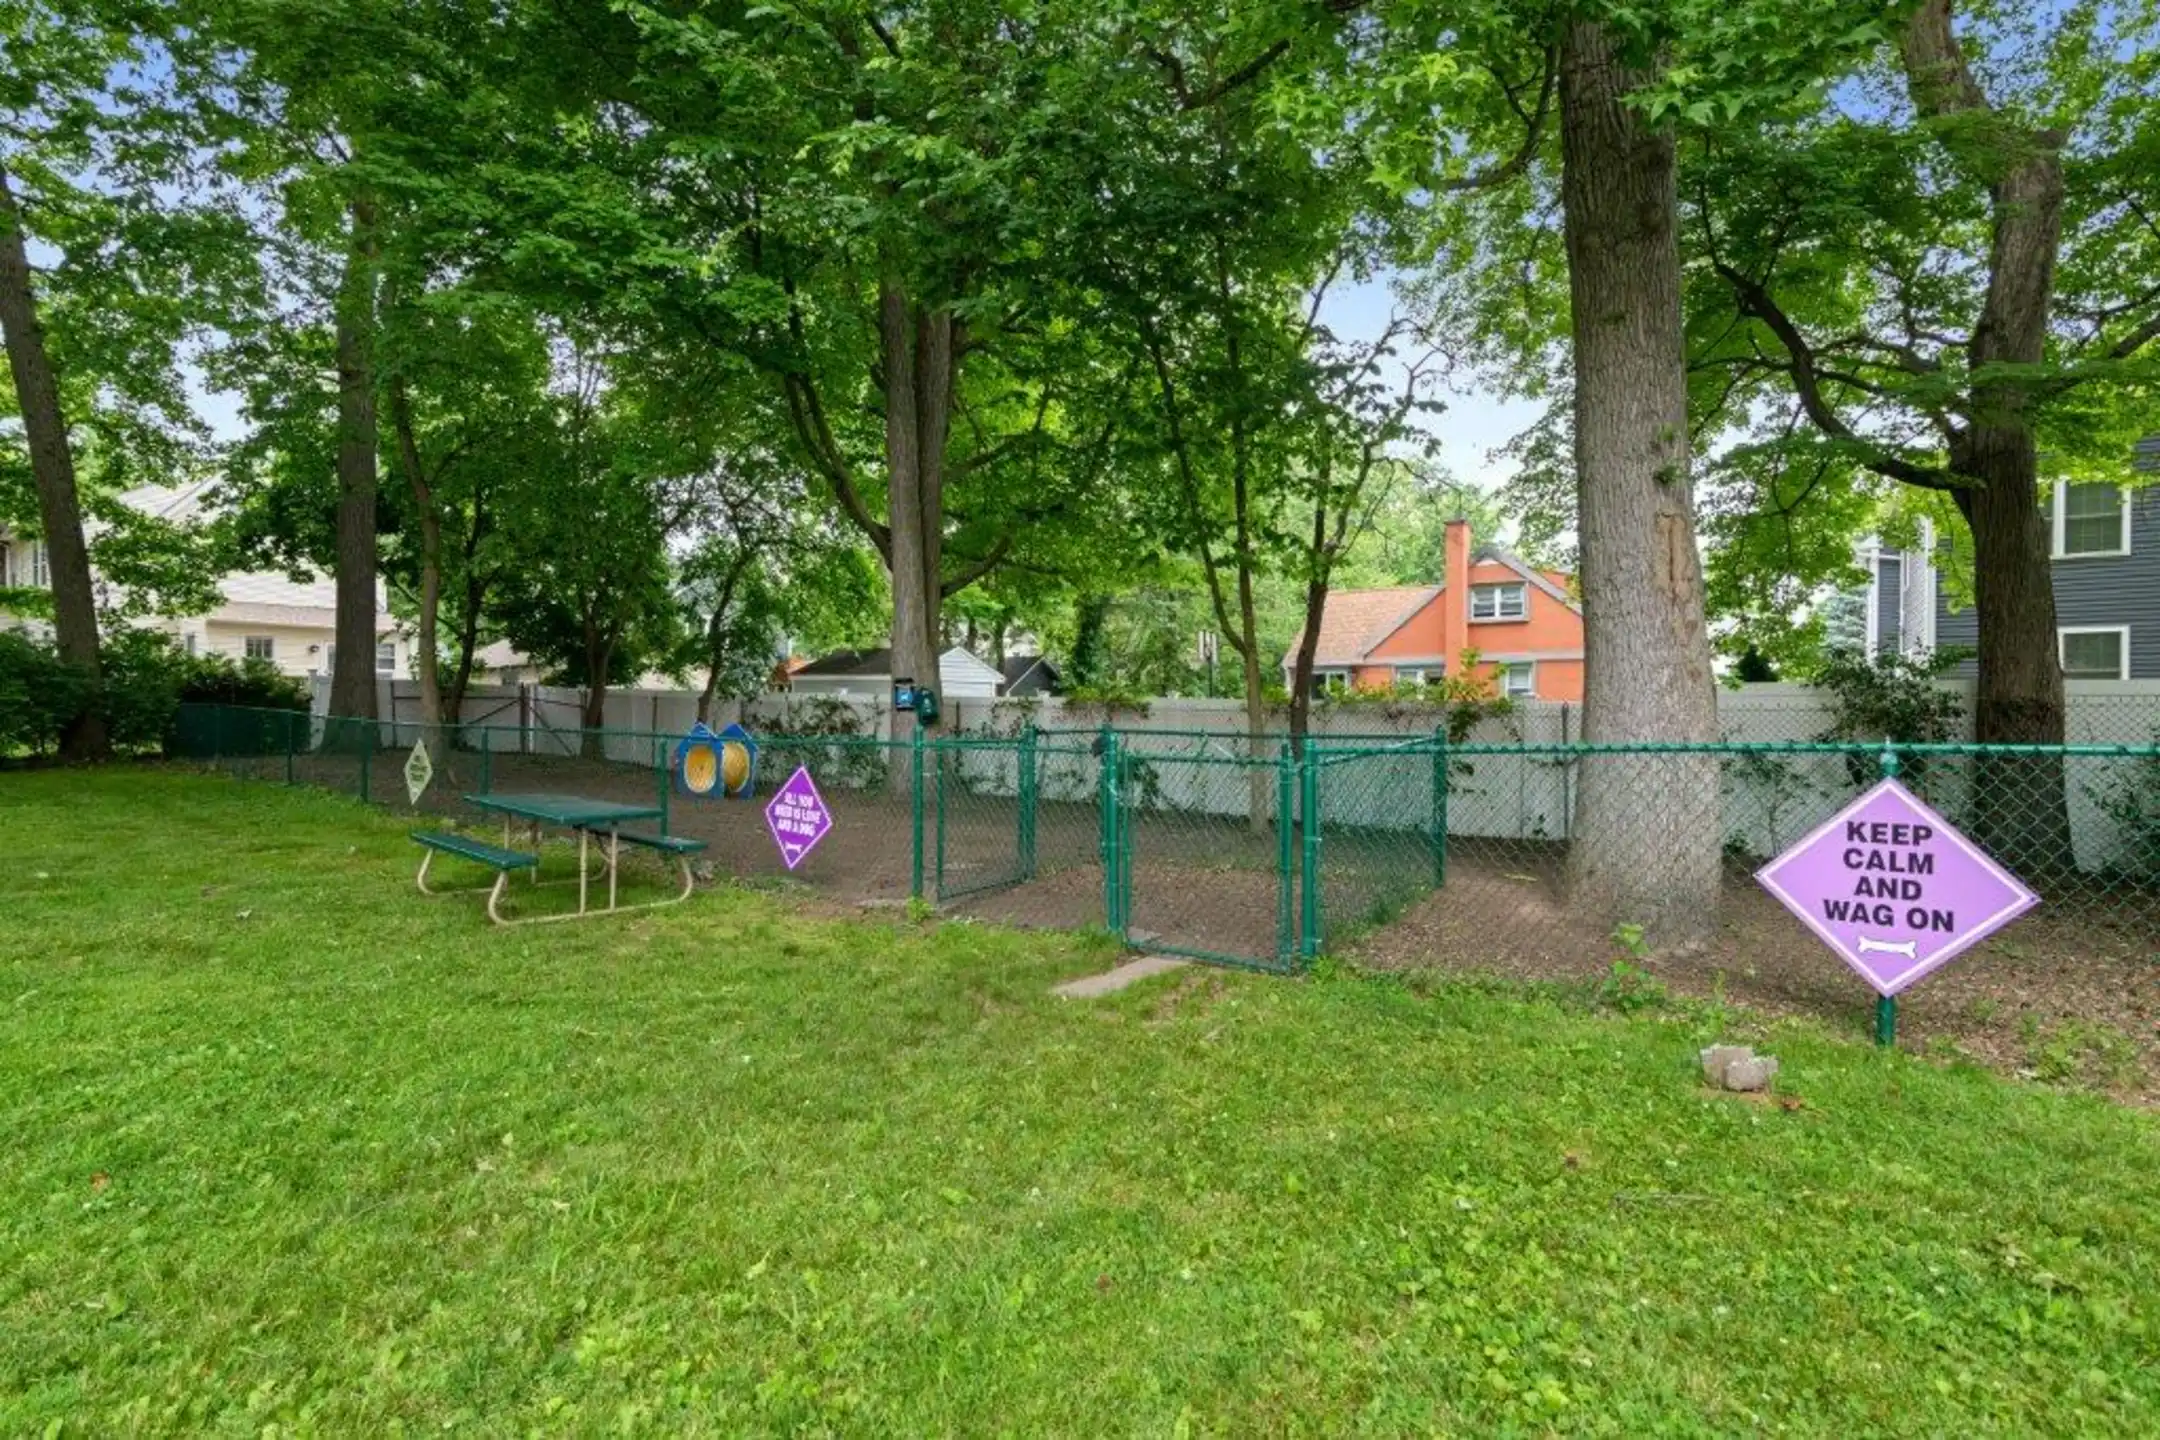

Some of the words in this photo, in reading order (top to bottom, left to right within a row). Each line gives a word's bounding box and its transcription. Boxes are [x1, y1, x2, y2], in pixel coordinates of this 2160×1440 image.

[1847, 821, 1933, 846] KEEP
[1843, 848, 1934, 875] CALM
[1854, 876, 1922, 900] AND
[1823, 899, 1894, 926] WAG
[1906, 907, 1955, 932] ON
